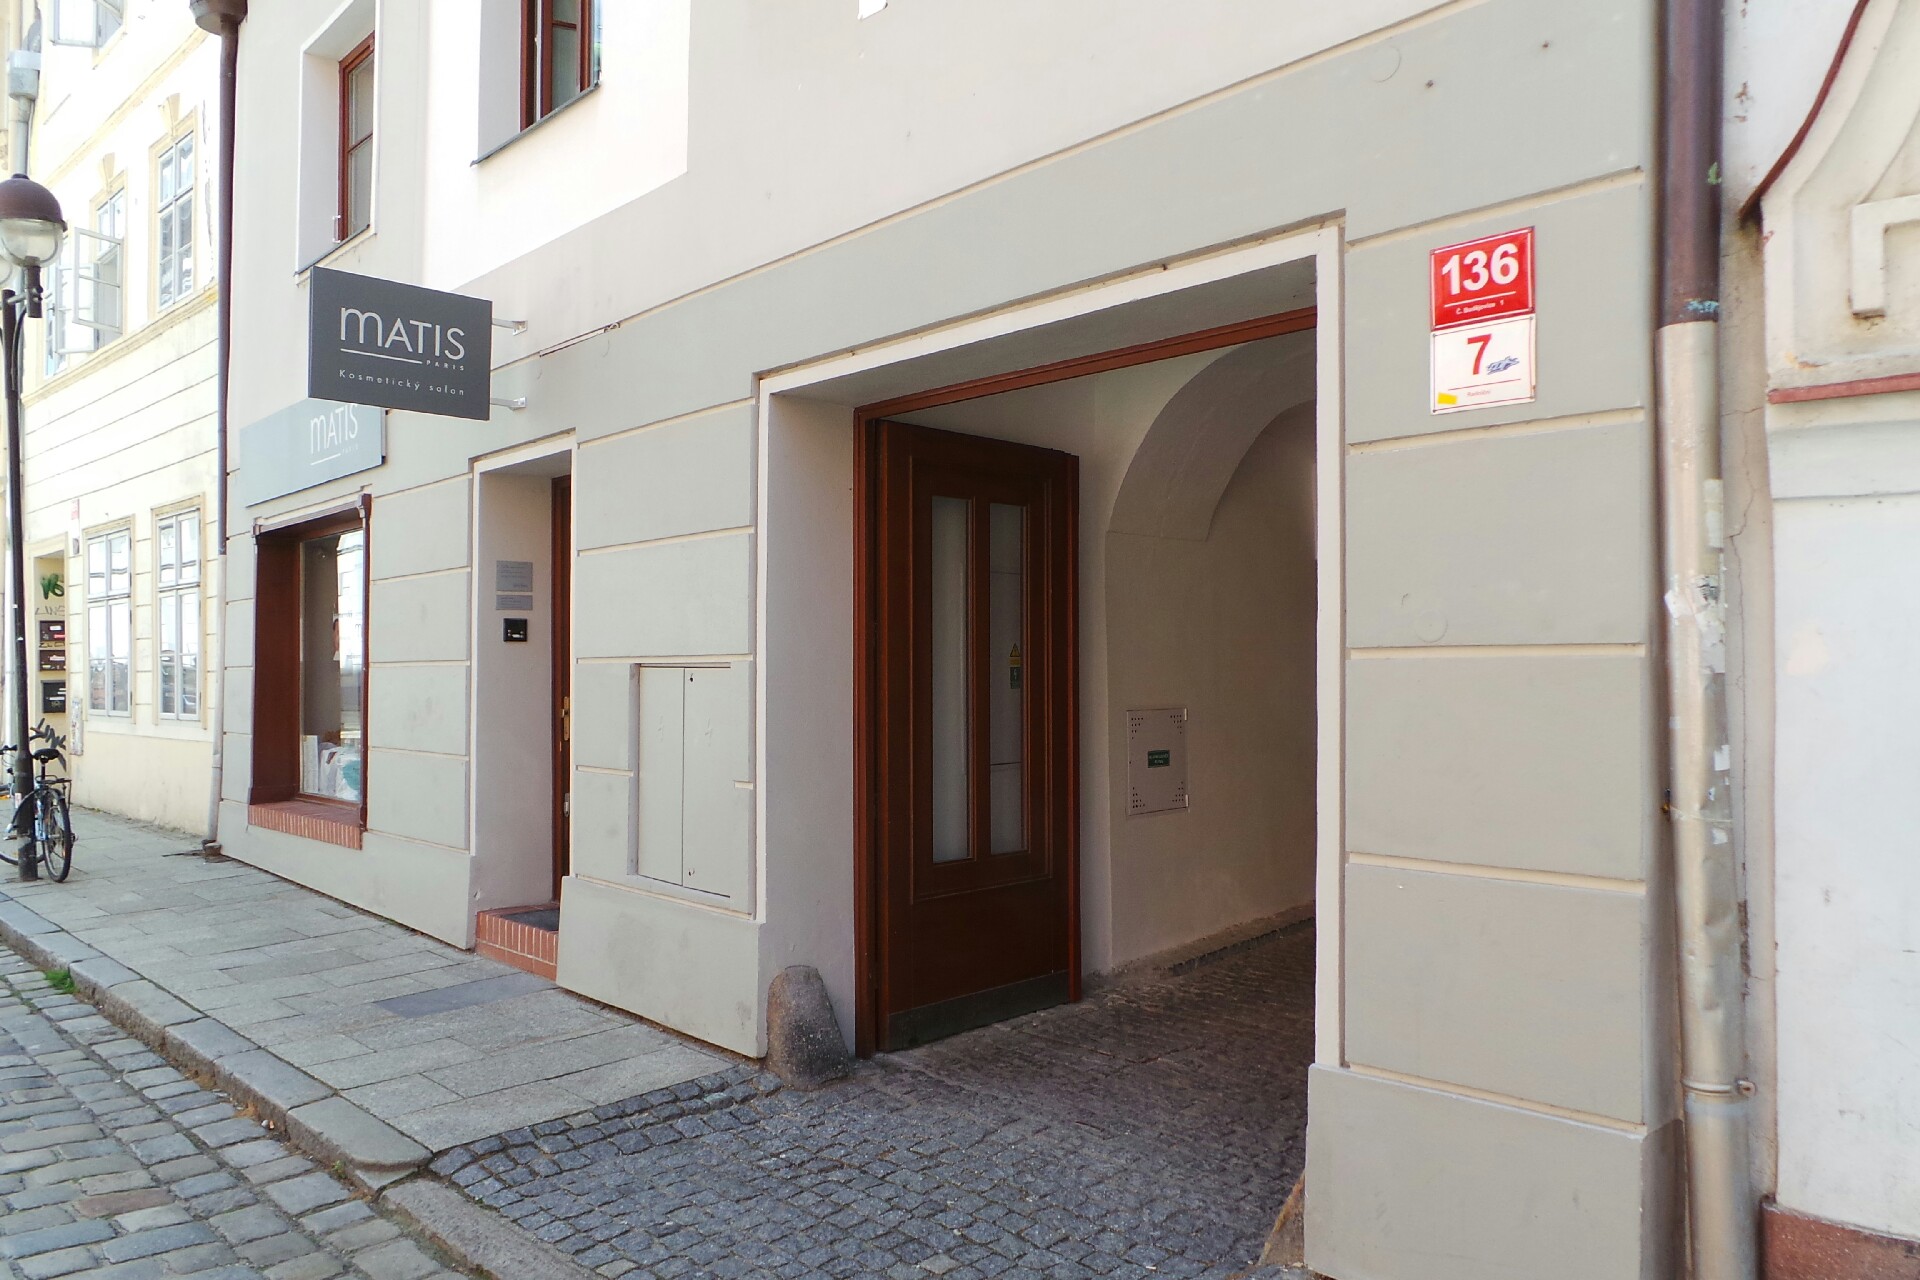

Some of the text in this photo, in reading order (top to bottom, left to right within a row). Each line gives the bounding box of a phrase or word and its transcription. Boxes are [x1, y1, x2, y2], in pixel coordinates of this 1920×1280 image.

[1442, 243, 1519, 295] 136
[426, 359, 464, 371] PARIS
[1467, 333, 1492, 375] 7
[339, 369, 464, 396] Kosmetický salon
